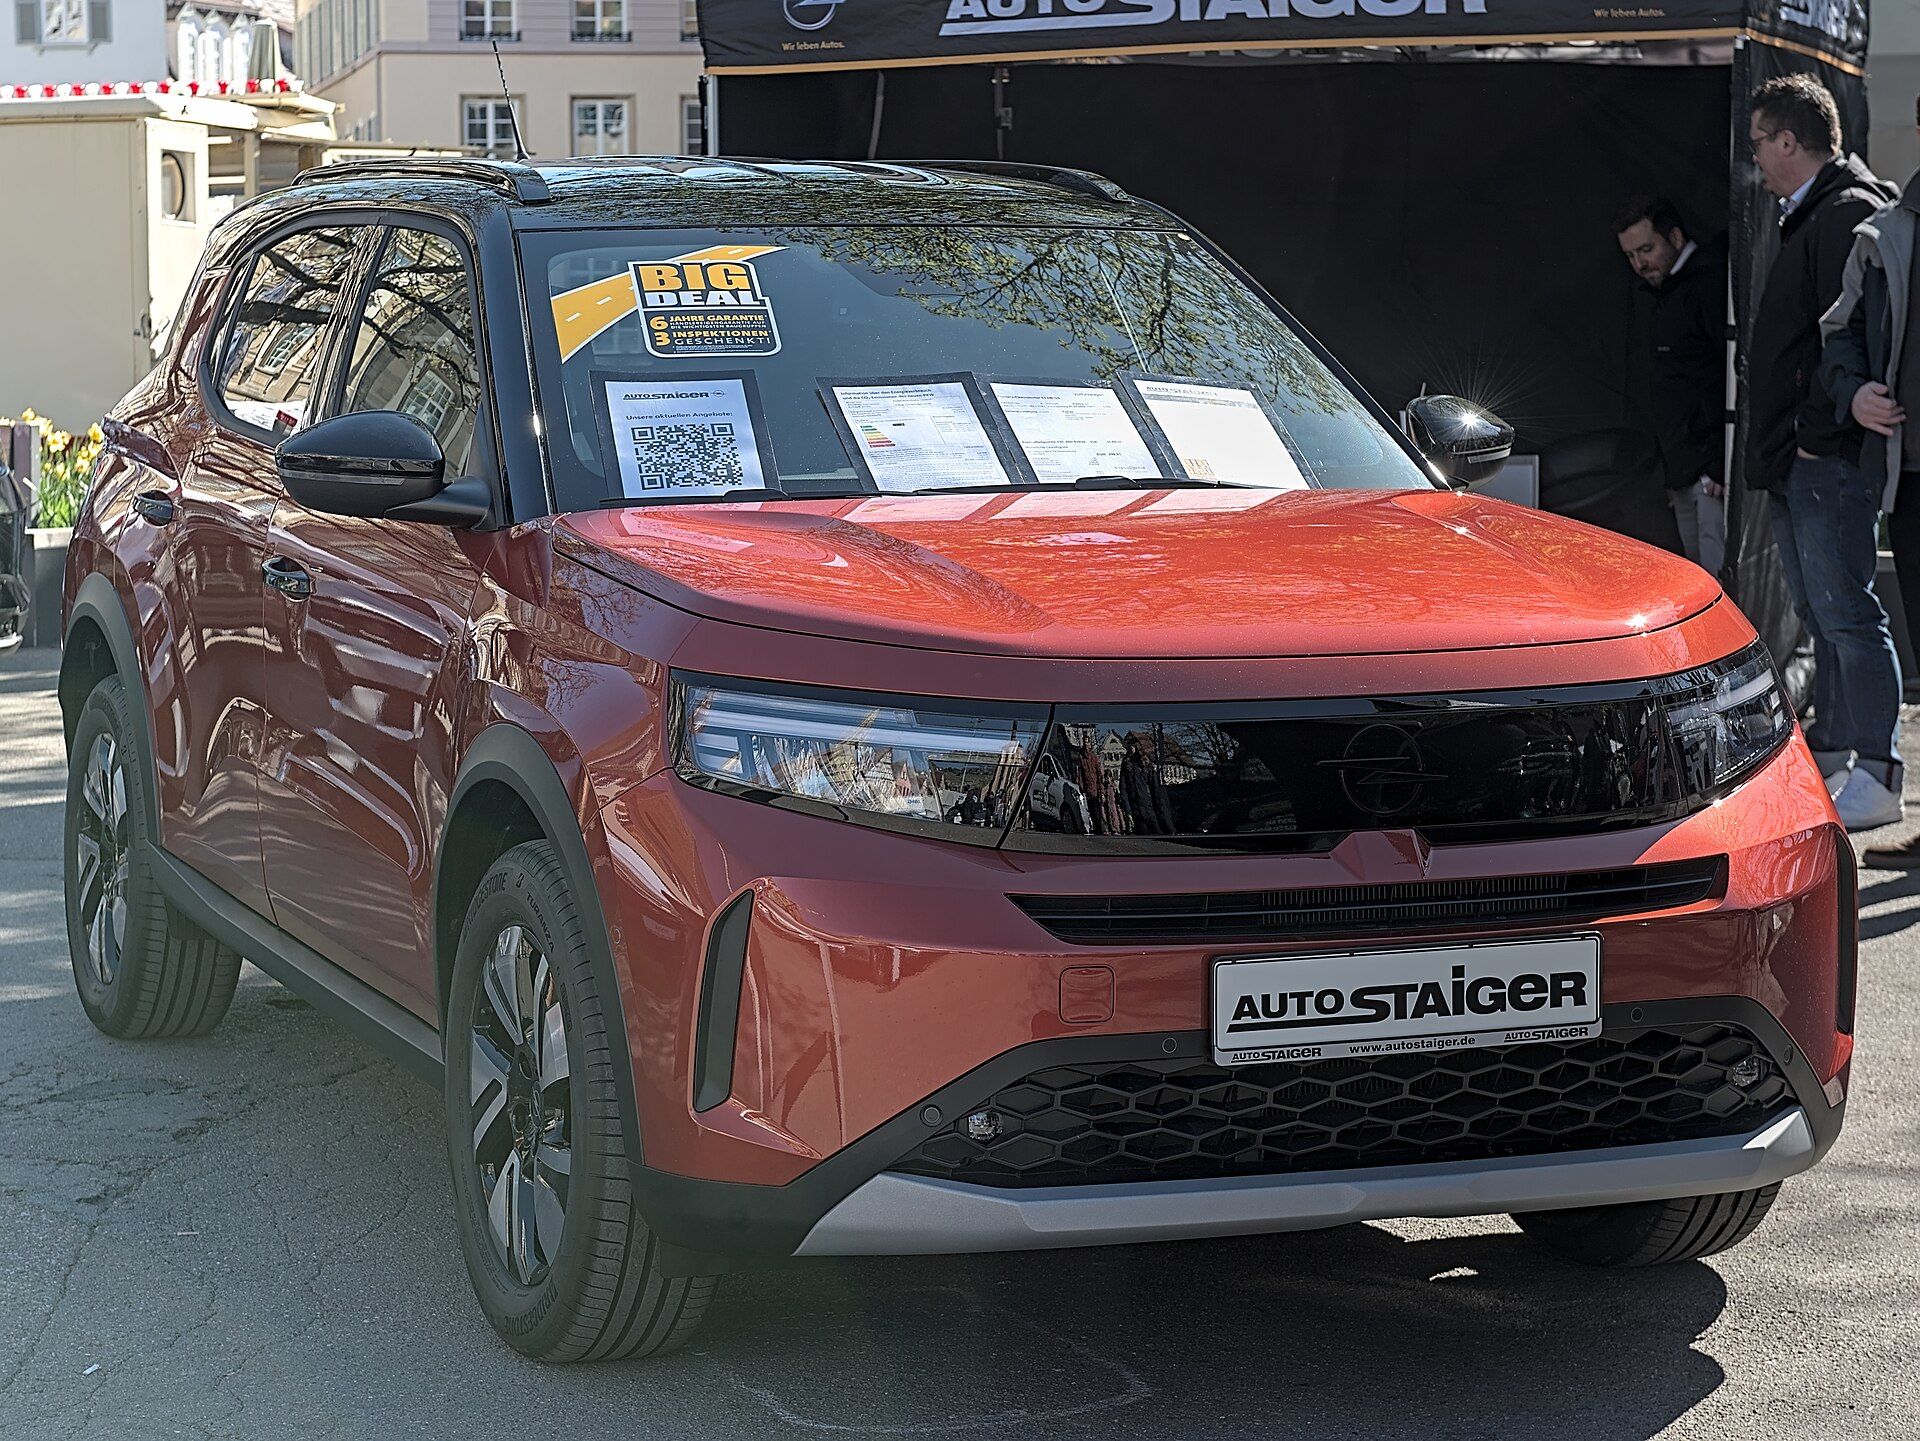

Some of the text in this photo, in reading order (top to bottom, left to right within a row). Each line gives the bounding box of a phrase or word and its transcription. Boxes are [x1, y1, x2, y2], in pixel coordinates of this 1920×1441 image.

[782, 42, 795, 51] Wir
[796, 41, 819, 51] leben
[638, 263, 751, 290] BIG
[644, 291, 760, 307] DEAL
[650, 316, 668, 330] 6
[653, 331, 671, 346] 3
[674, 337, 770, 345] GESCHENKT!
[526, 891, 555, 953] TURANZA
[1231, 988, 1345, 1021] AUTO
[1504, 1031, 1531, 1041] AUTO
[1348, 1035, 1476, 1054] www.autostaiger.de
[1232, 1051, 1260, 1061] AUTO
